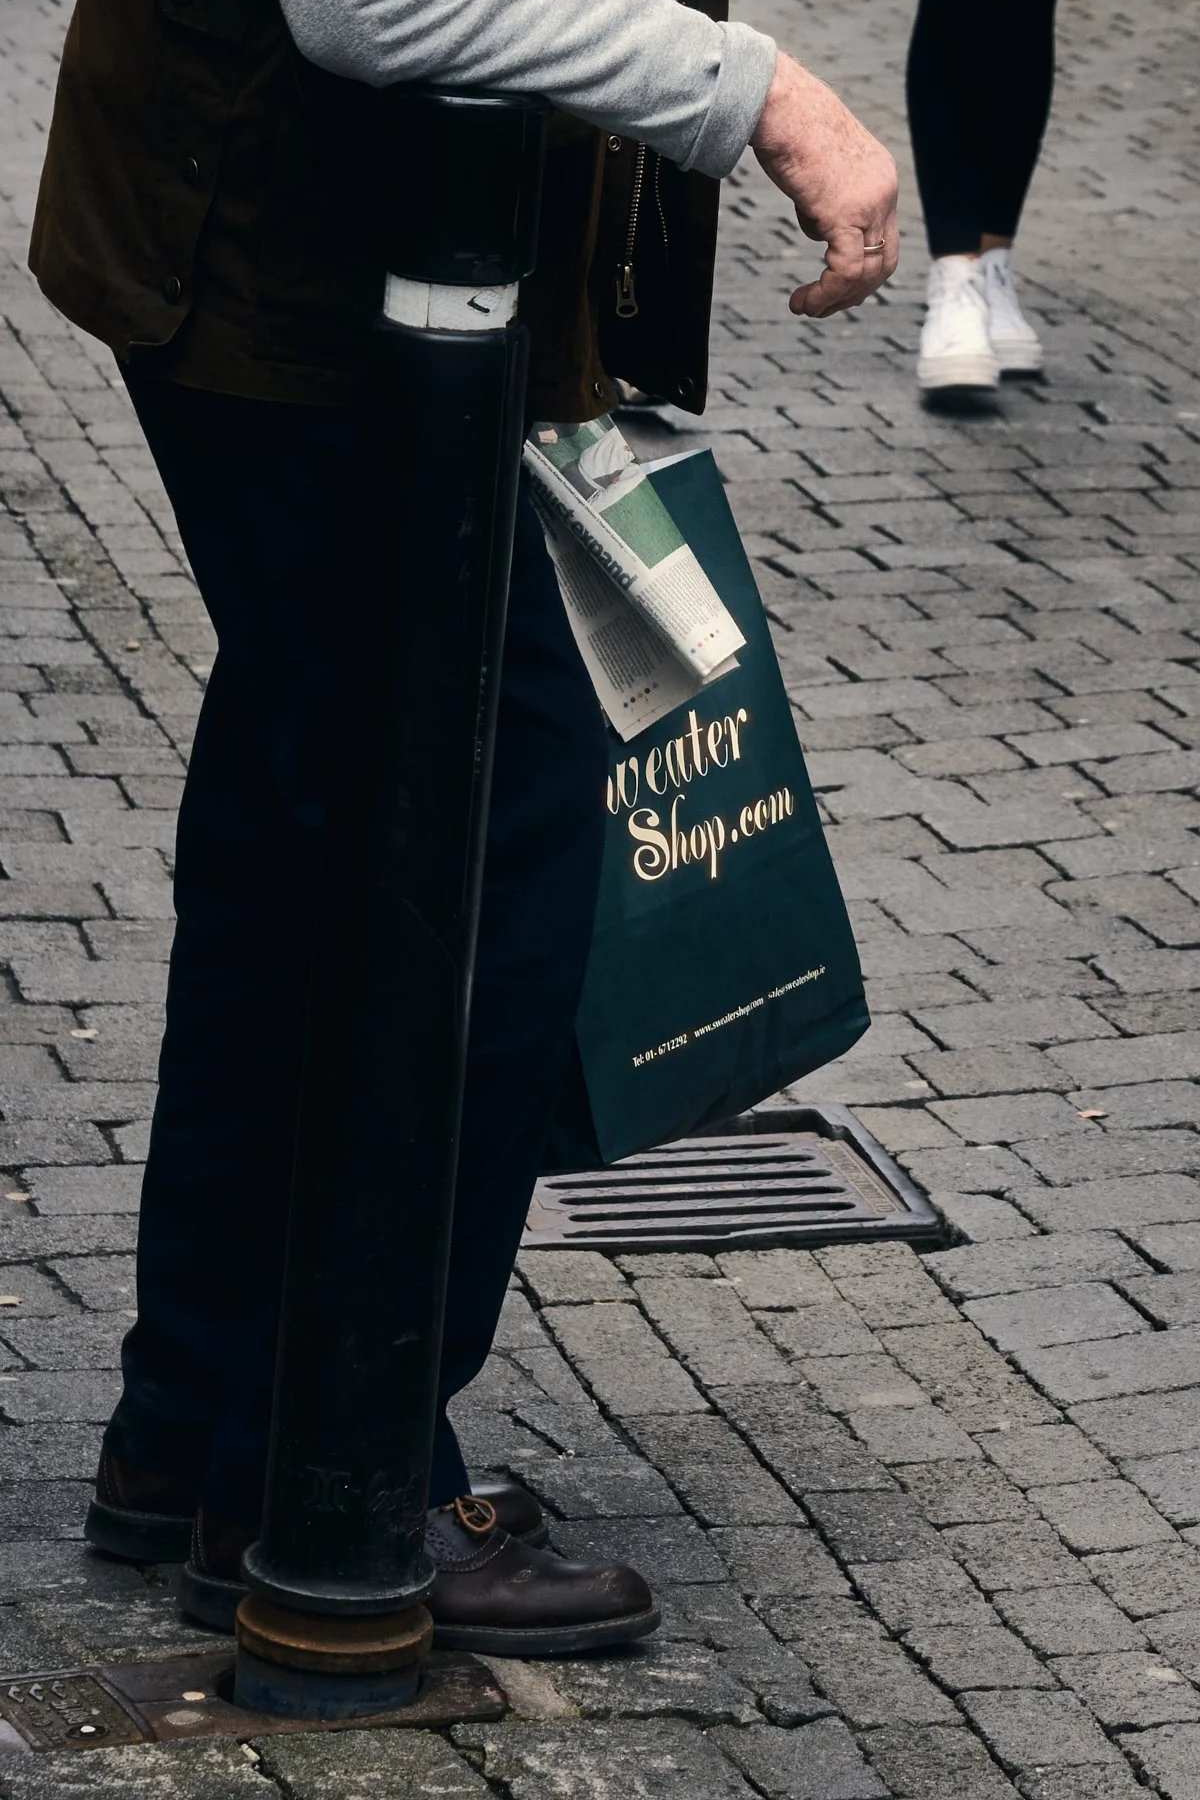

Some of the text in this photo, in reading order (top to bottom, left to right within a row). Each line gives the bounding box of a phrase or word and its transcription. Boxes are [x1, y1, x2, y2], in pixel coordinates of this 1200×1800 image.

[569, 519, 638, 590] expand
[628, 794, 794, 881] Shop.com
[658, 1033, 688, 1056] 6712292
[694, 997, 764, 1038] www.sweatershop.com
